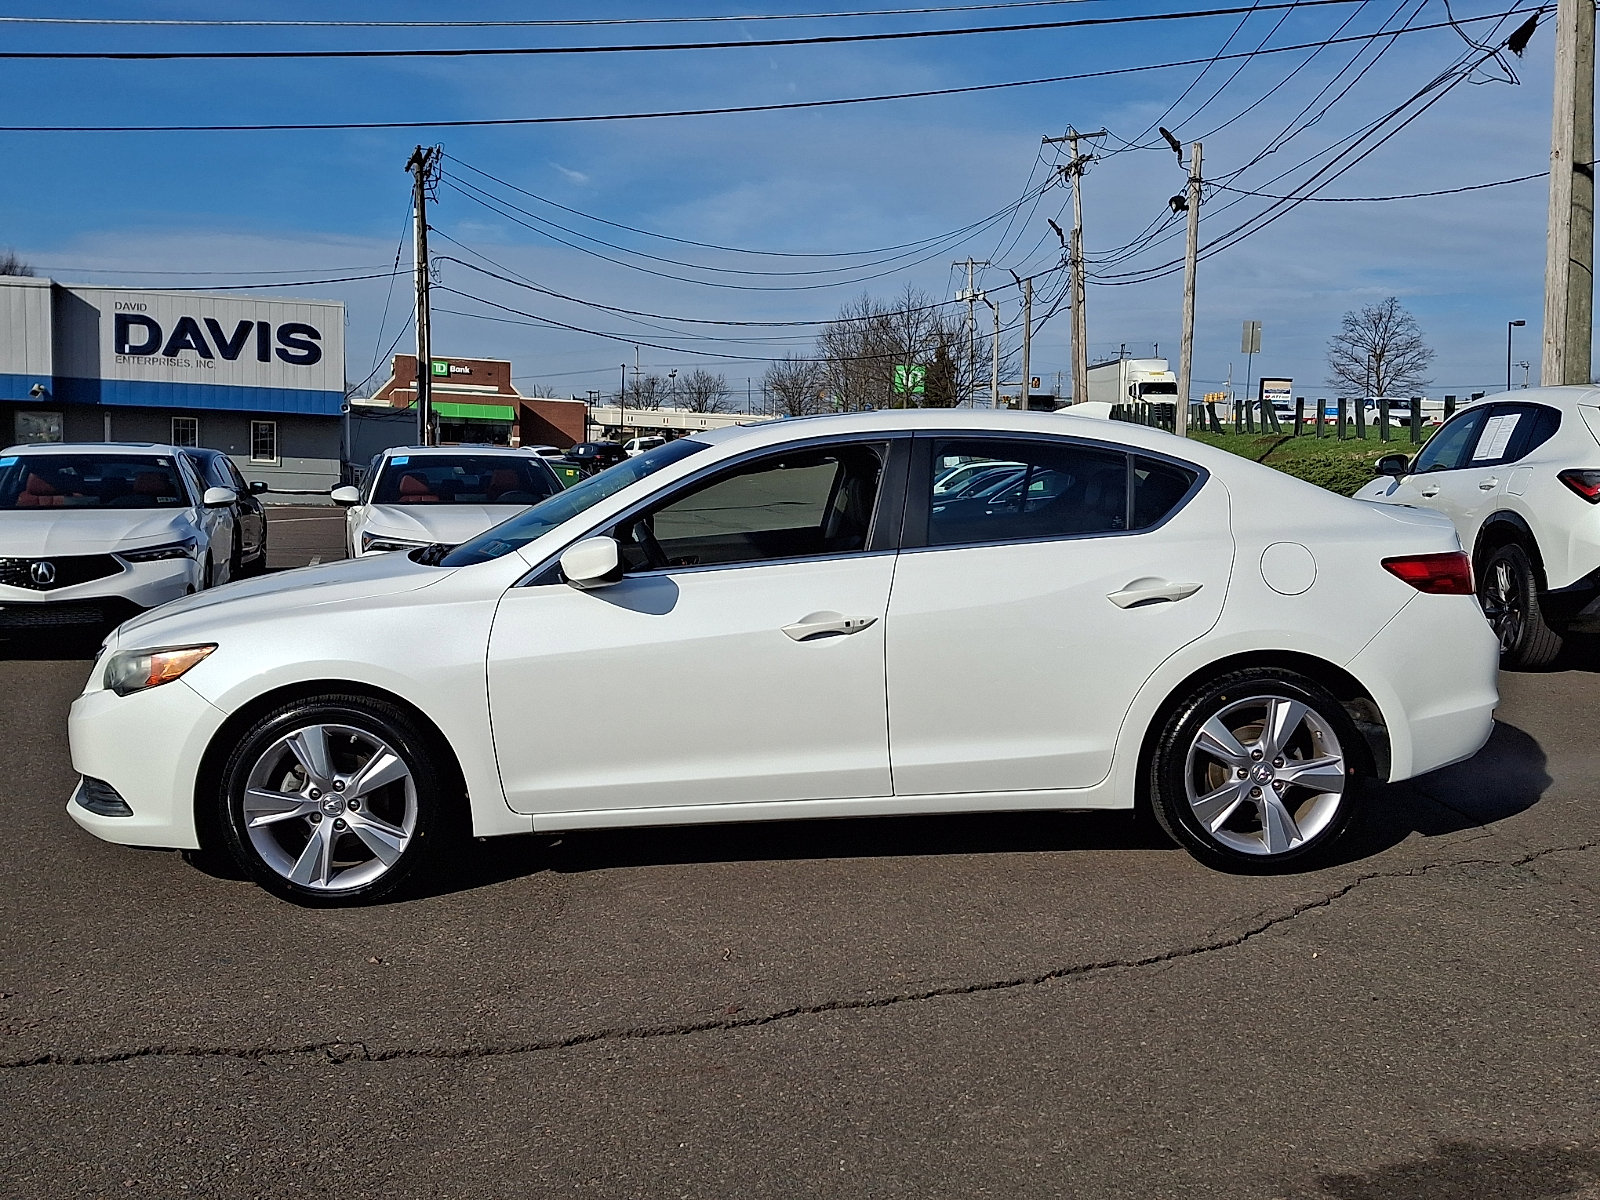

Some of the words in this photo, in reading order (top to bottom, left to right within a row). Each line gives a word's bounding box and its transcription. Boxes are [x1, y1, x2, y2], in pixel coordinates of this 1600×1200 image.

[114, 301, 147, 312] DAVID
[114, 312, 322, 366] DAVIS
[432, 362, 447, 374] TD
[450, 365, 471, 374] Bank
